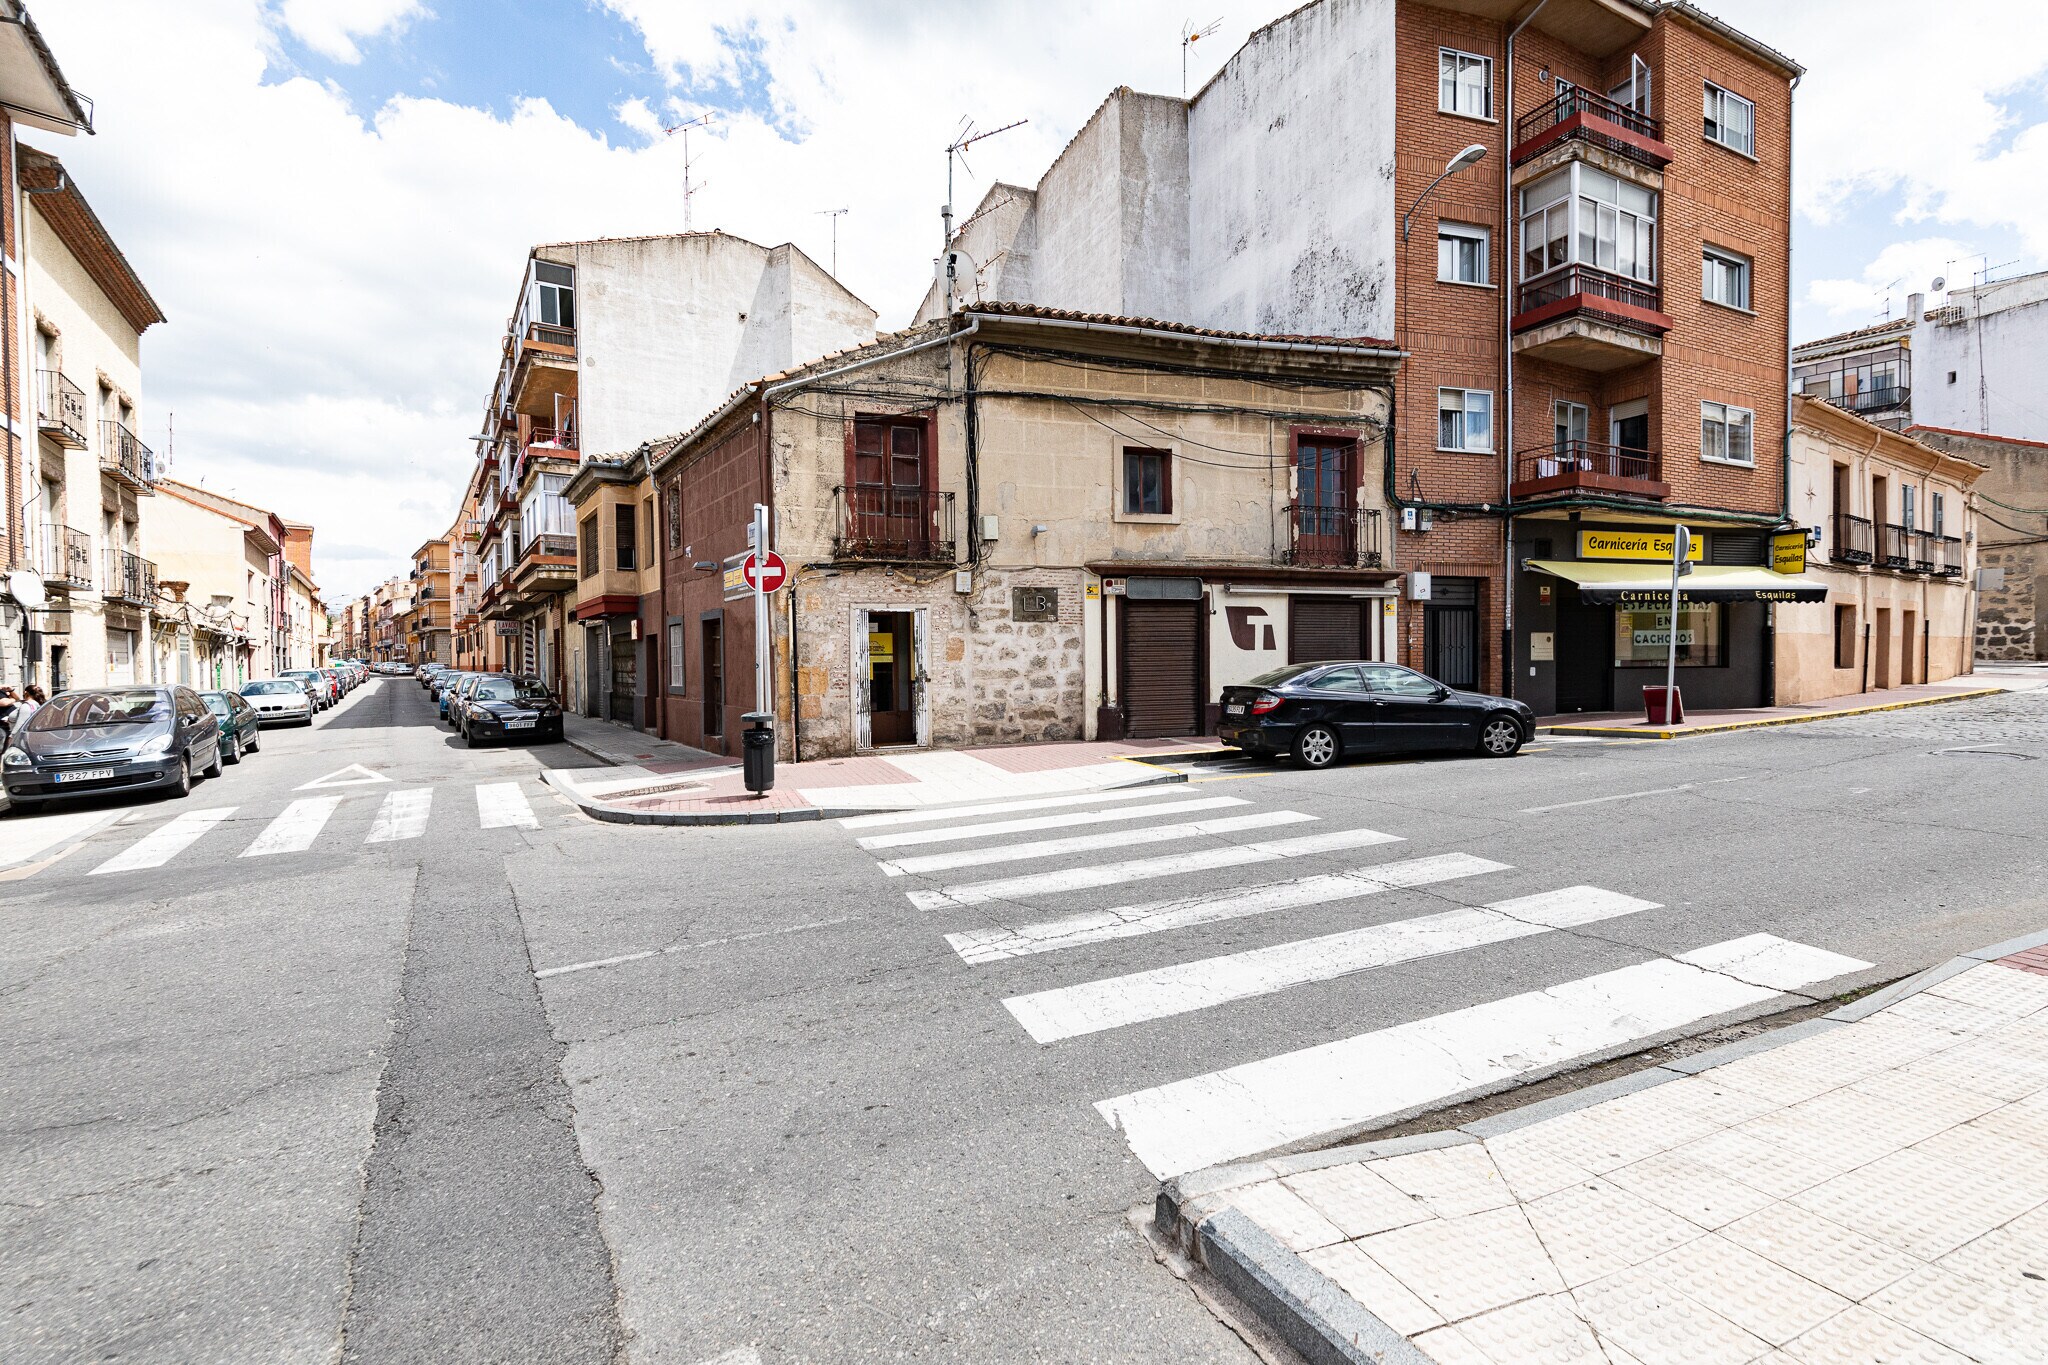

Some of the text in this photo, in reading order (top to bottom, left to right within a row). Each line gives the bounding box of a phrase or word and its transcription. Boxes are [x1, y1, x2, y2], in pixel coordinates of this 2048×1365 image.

[1588, 536, 1648, 551] Carnicería
[1774, 553, 1803, 565] Esquilas
[1621, 591, 1797, 601] Carniceia Esquilas
[61, 769, 112, 781] 7827 FPV
